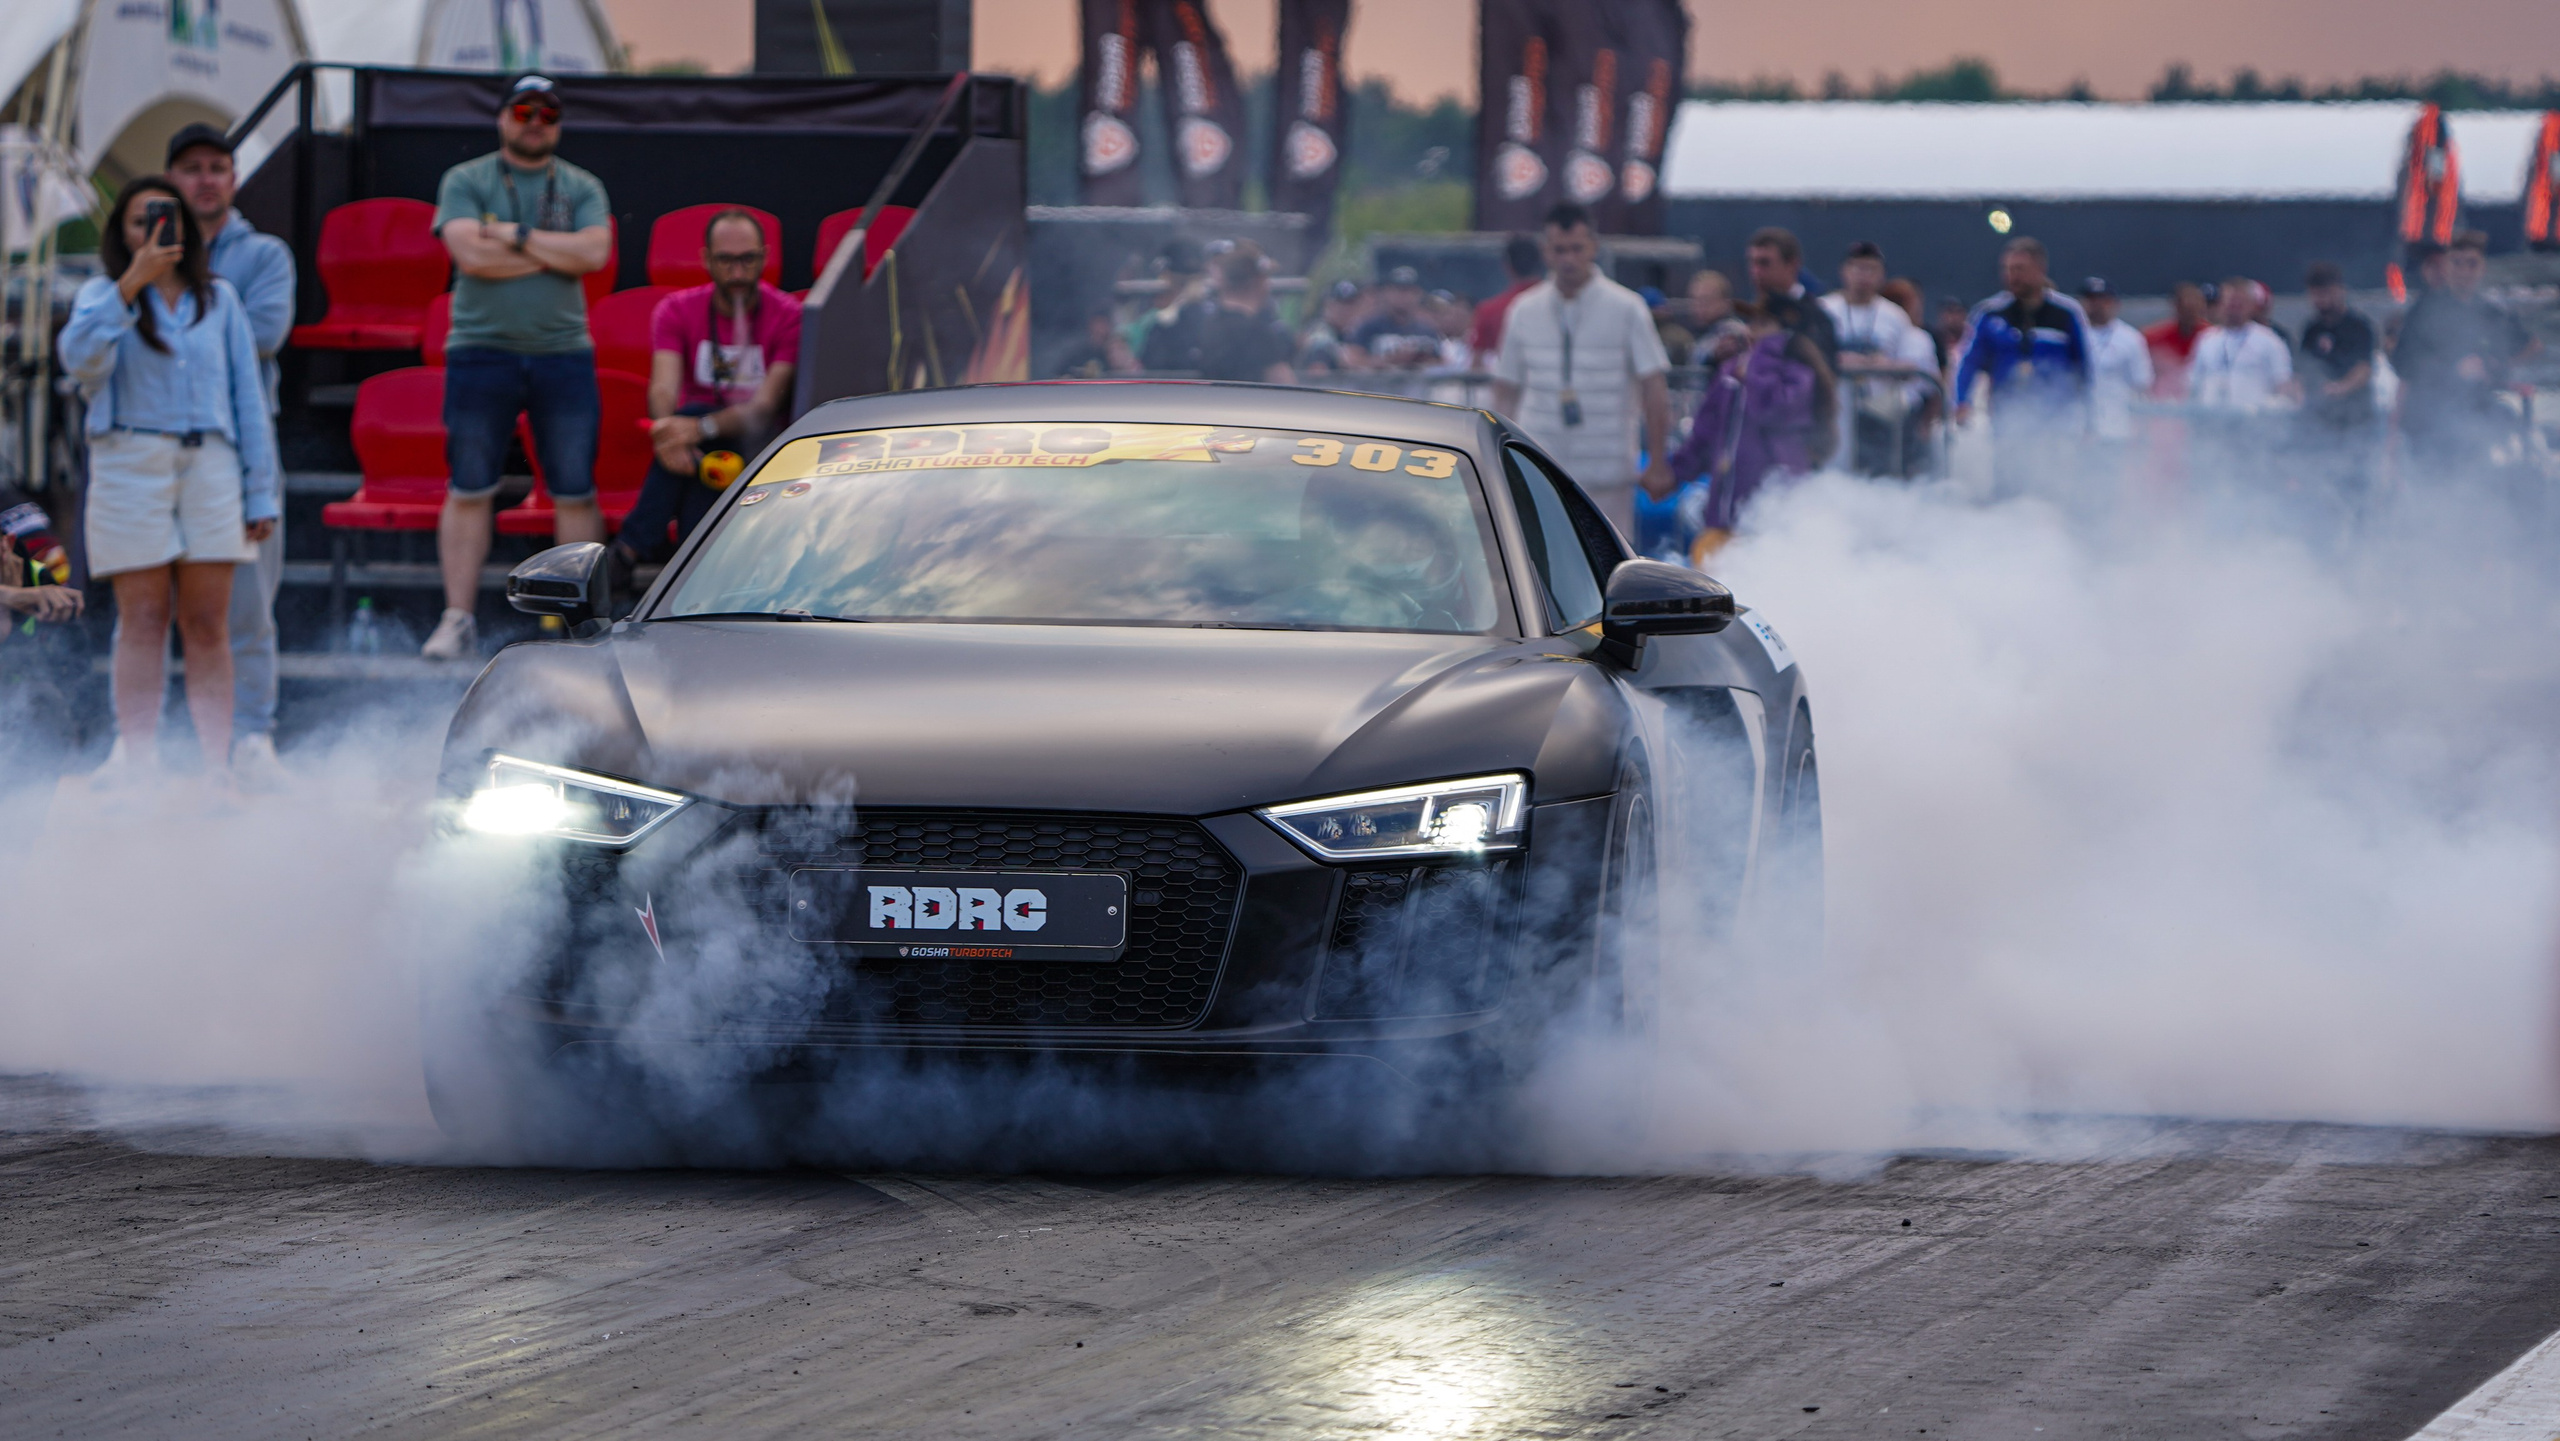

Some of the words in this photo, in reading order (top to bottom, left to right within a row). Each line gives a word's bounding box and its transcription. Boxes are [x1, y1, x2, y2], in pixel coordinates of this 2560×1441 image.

[817, 428, 1112, 464] RDRC
[1291, 437, 1458, 479] 303
[815, 454, 1090, 475] GOSHATURBOTECH
[867, 886, 1047, 931] RDRC
[911, 946, 1013, 958] GOSHATURBOTECH
